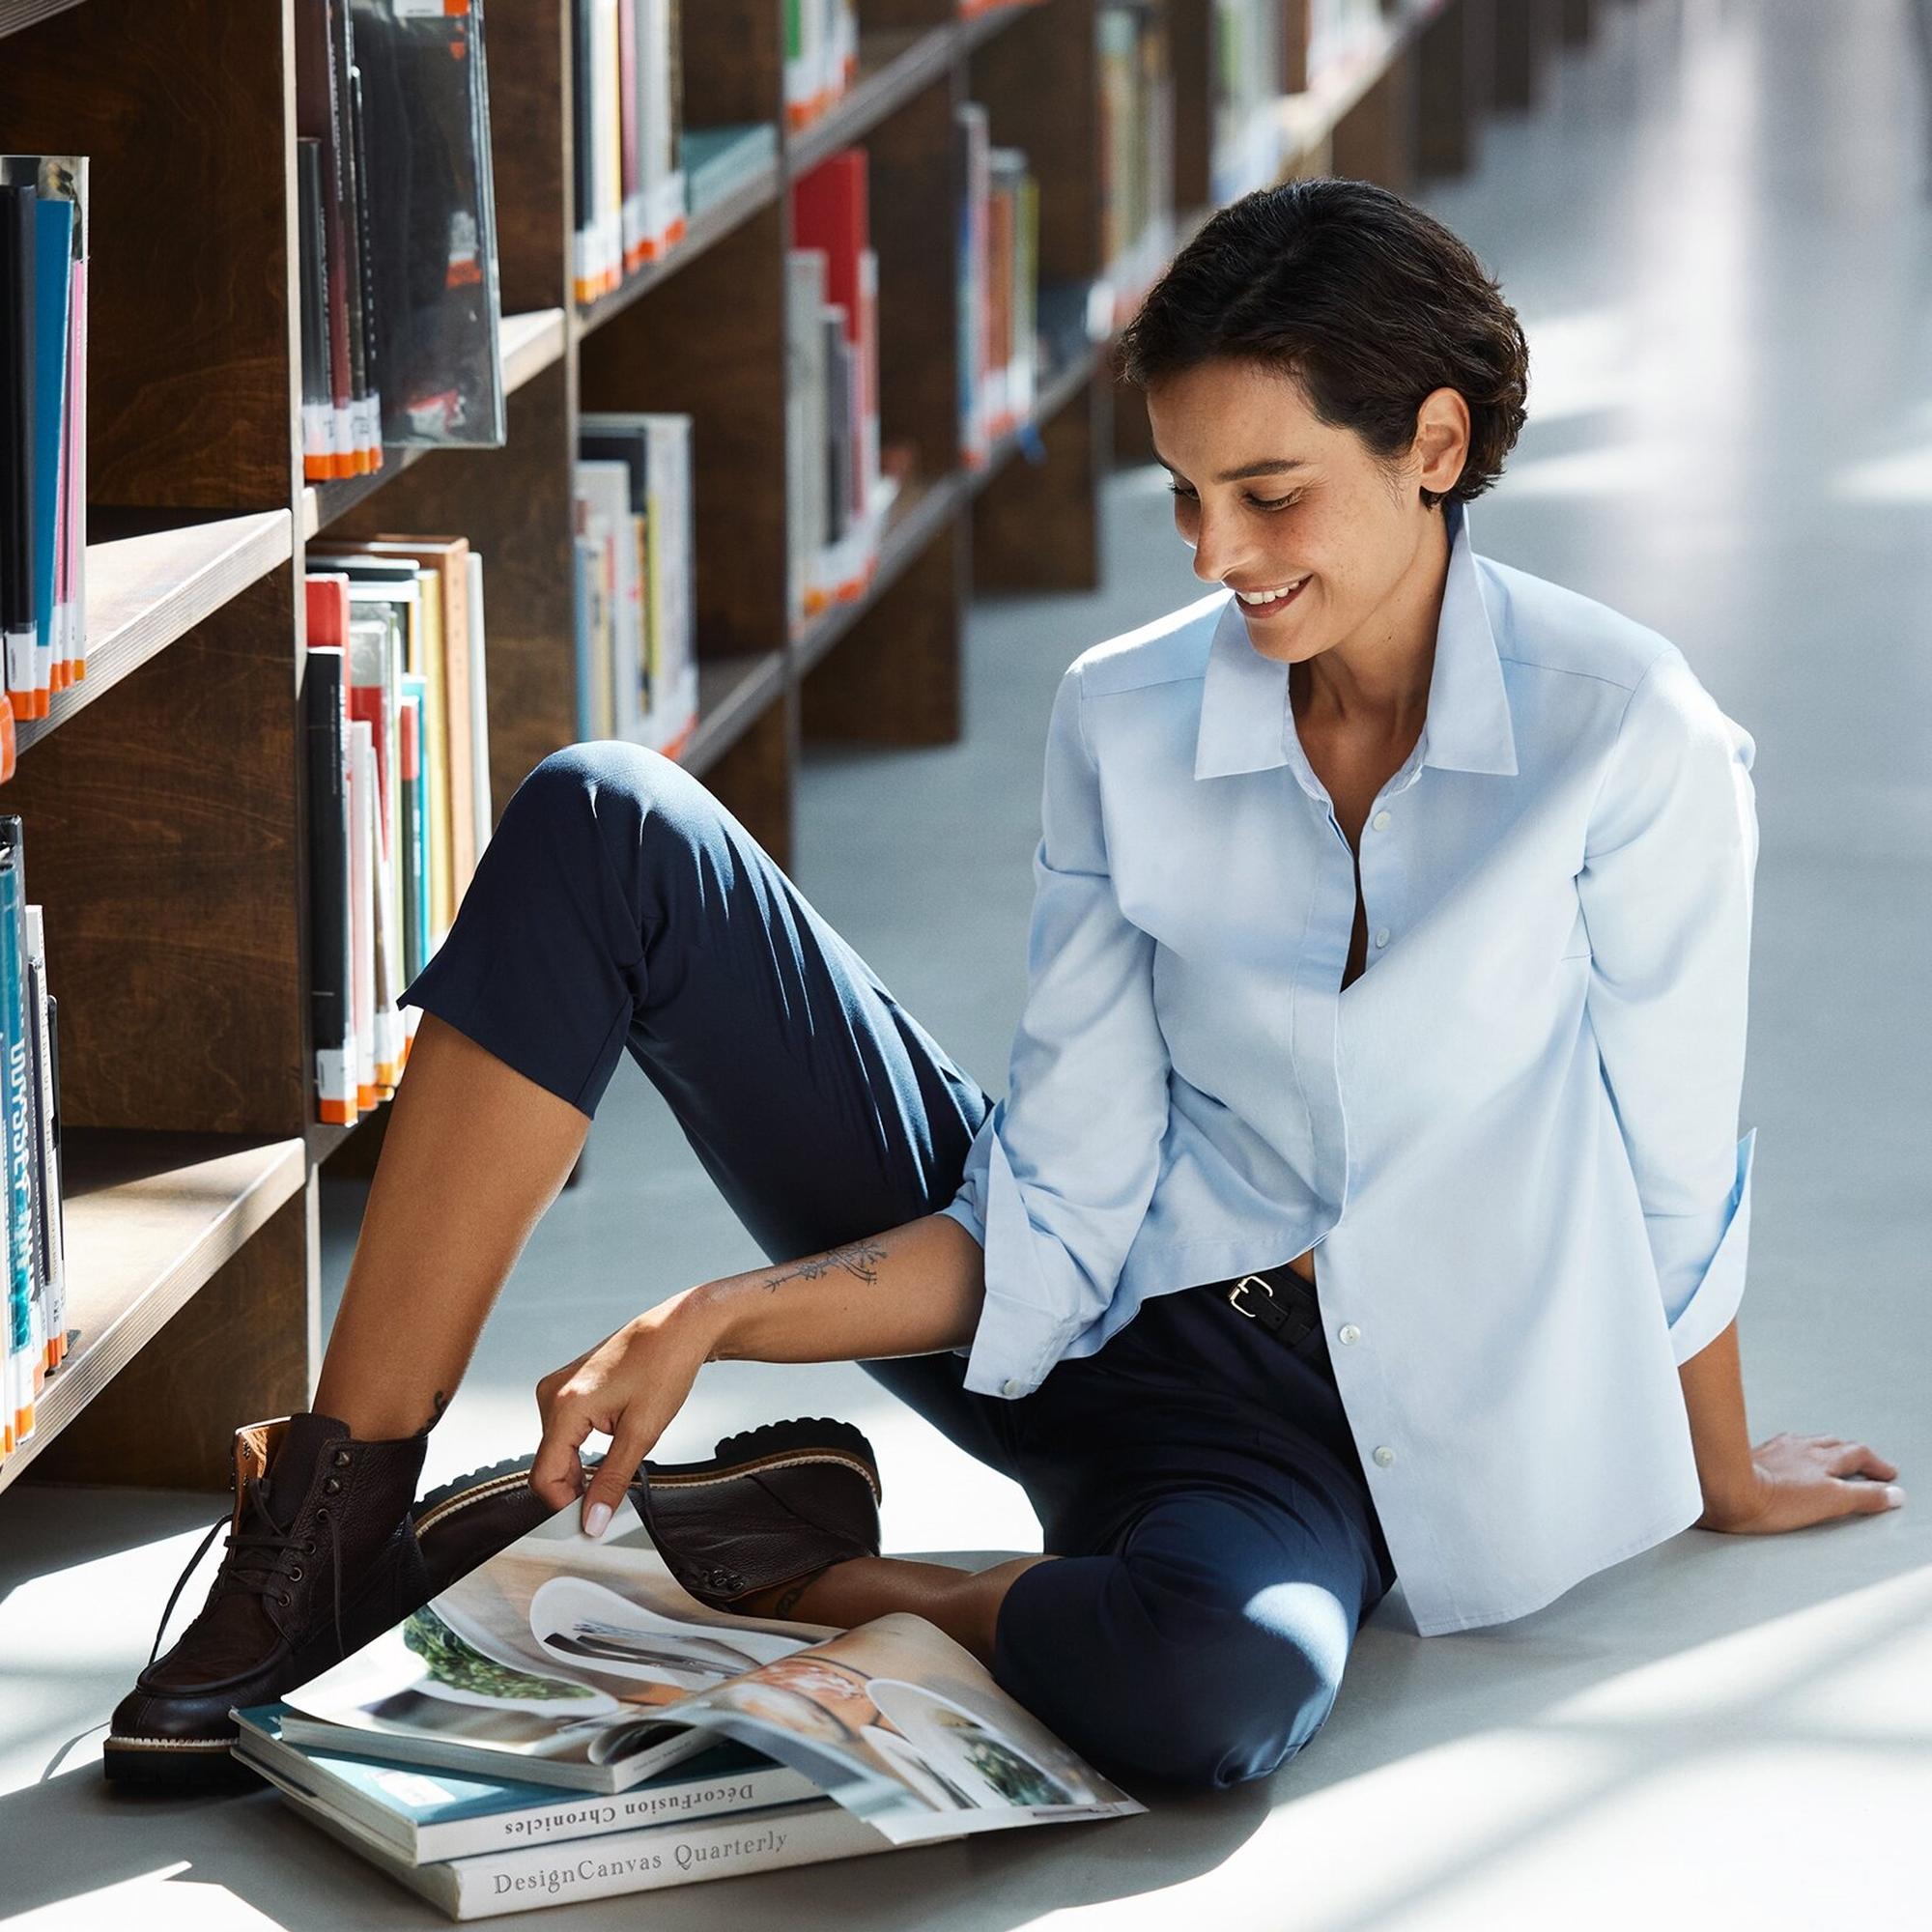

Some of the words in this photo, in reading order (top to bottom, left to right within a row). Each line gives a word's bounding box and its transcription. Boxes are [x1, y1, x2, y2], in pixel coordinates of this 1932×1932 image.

[625, 1784, 754, 1815] DécorFusion
[504, 1806, 616, 1835] Chronicles
[494, 1855, 662, 1894] DesignCanvas
[674, 1831, 787, 1871] Quarterly
